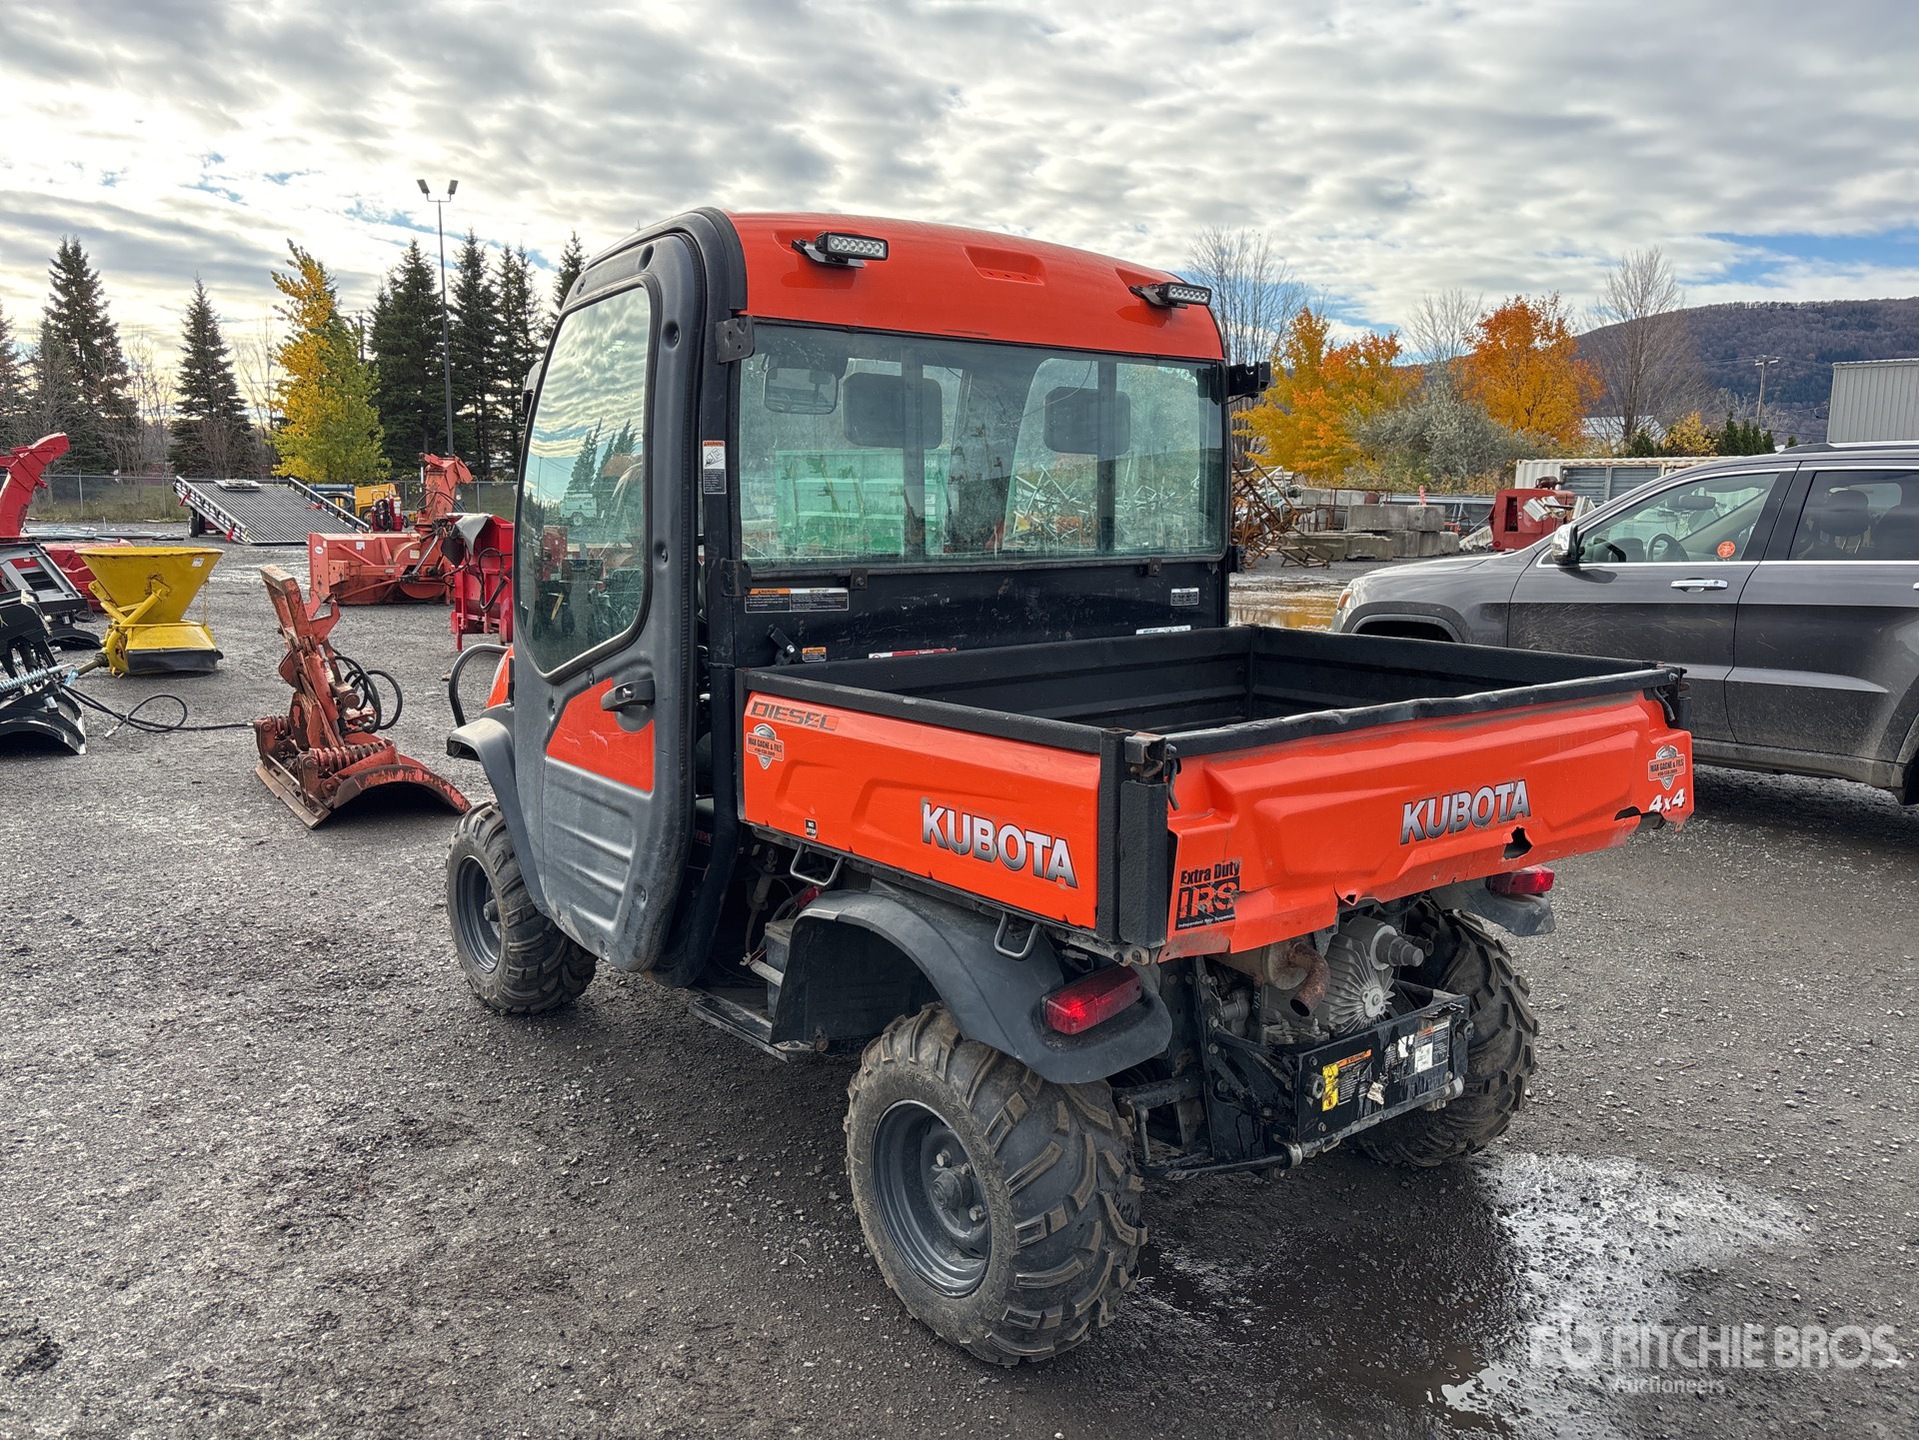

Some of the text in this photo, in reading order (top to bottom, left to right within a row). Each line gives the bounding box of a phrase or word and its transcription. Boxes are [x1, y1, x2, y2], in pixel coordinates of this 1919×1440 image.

[751, 701, 837, 731] DIESEL
[1401, 779, 1531, 845] KUBOTA
[1649, 788, 1686, 813] 4x4
[921, 802, 1078, 889] KUBOTA
[1181, 861, 1240, 884] Extra Duty
[1179, 882, 1237, 918] IRS
